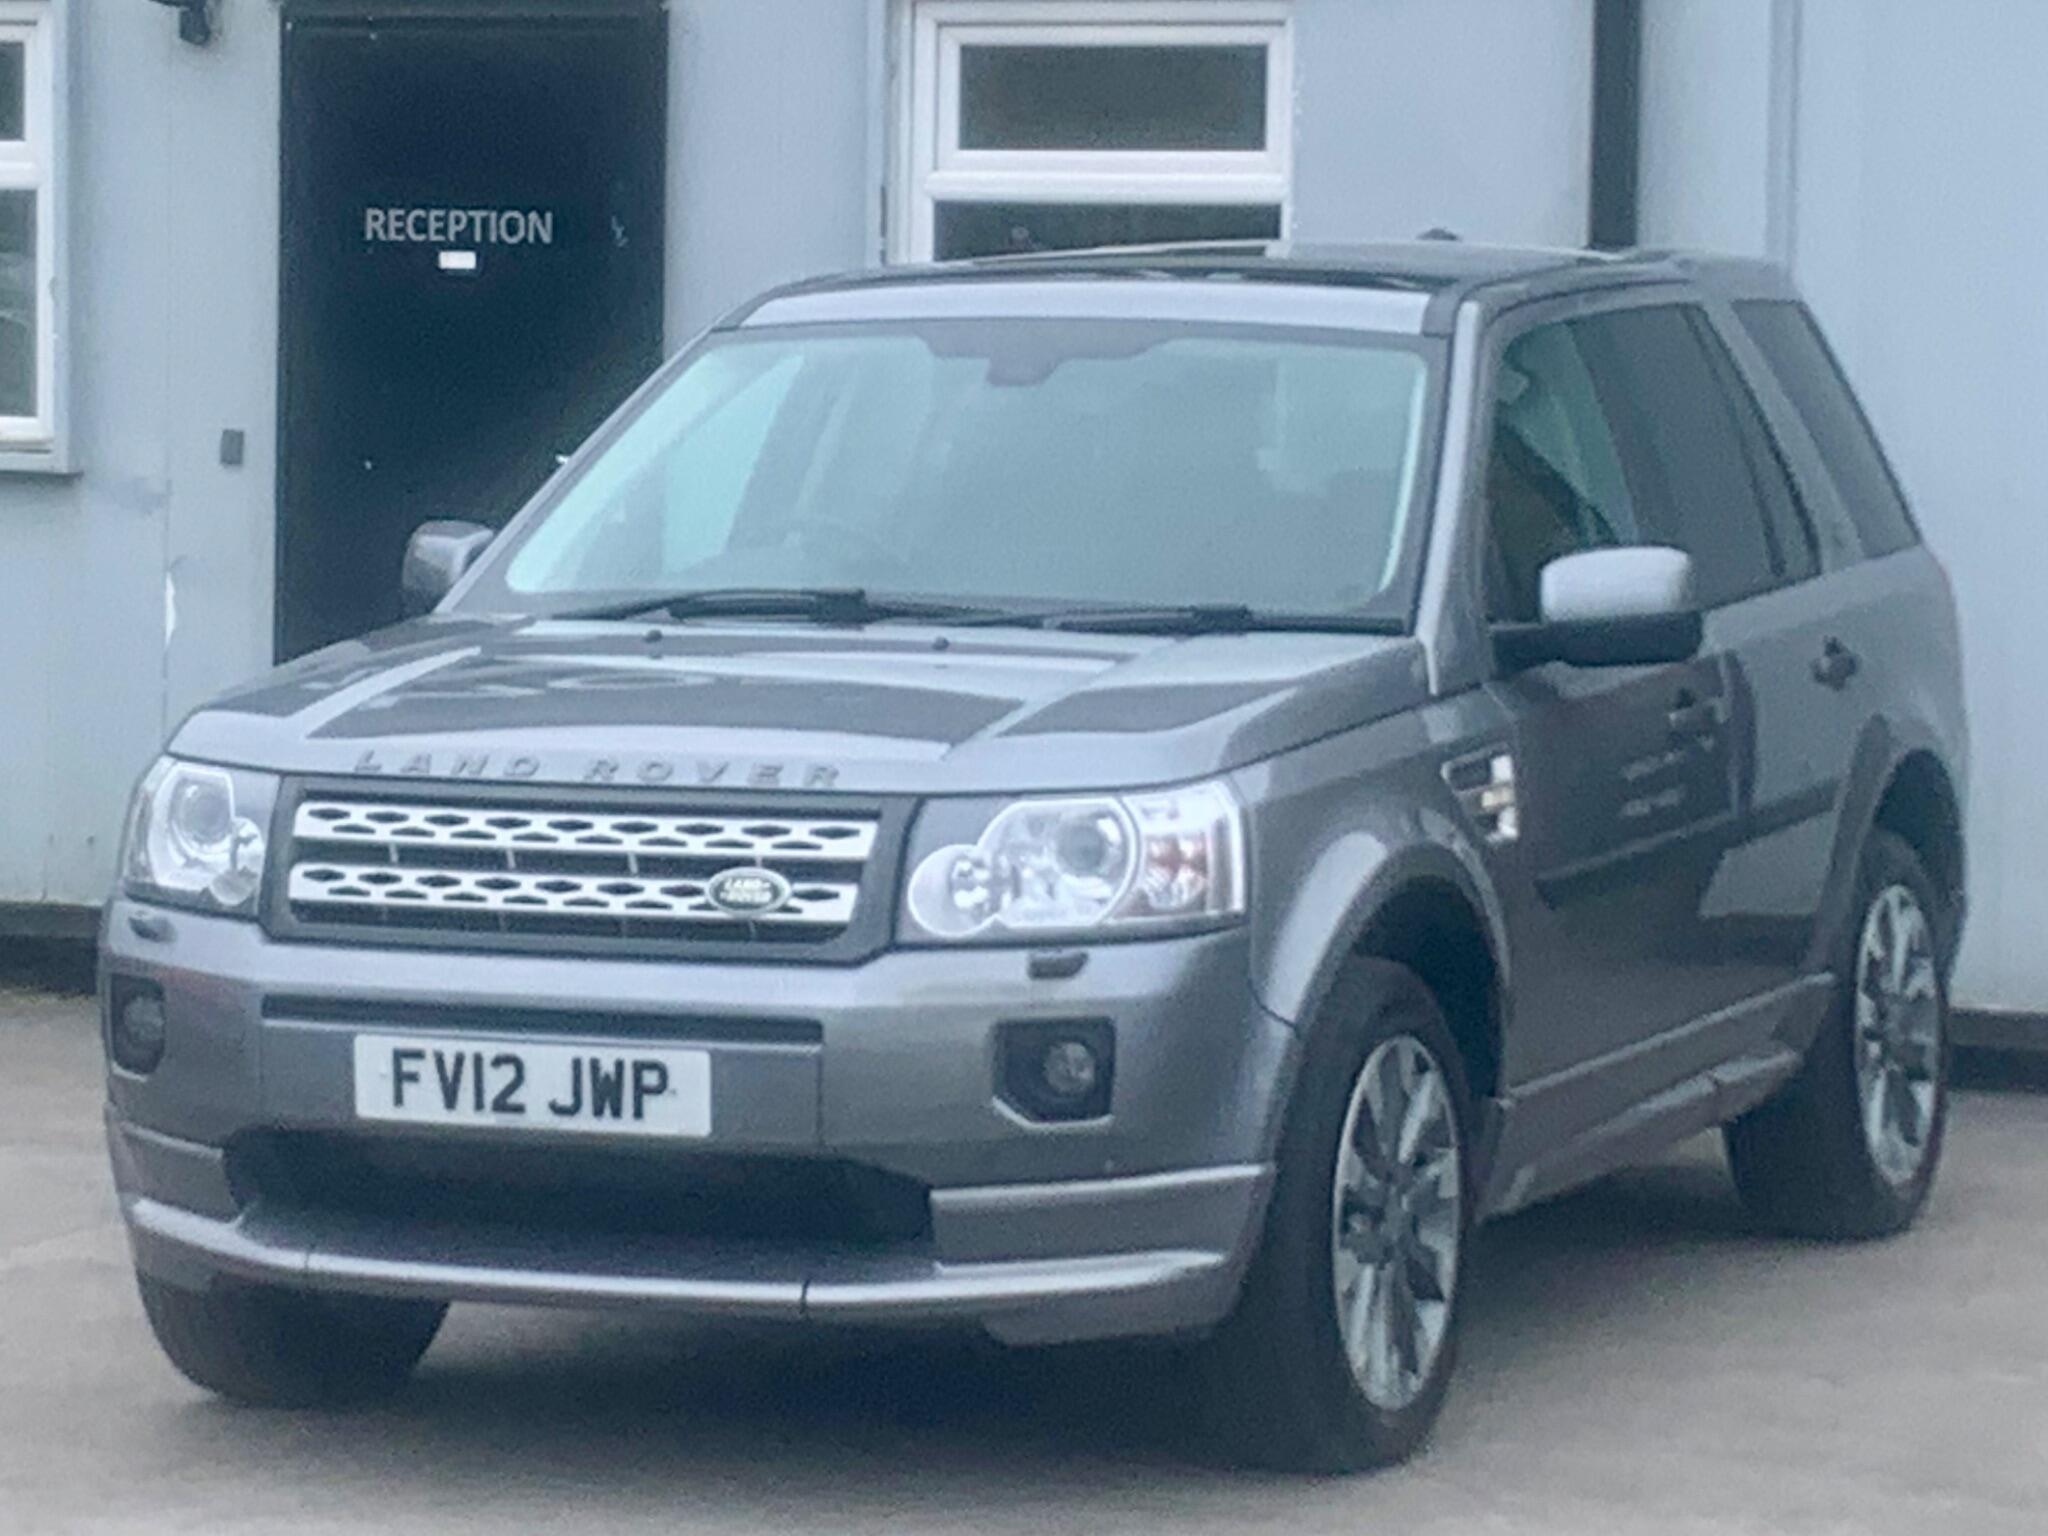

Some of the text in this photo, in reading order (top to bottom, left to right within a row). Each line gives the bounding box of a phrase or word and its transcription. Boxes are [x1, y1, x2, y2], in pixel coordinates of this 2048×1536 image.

[365, 208, 553, 244] RECEPTION
[354, 750, 839, 788] LAND ROVER
[392, 1048, 669, 1120] FV12 JWP
